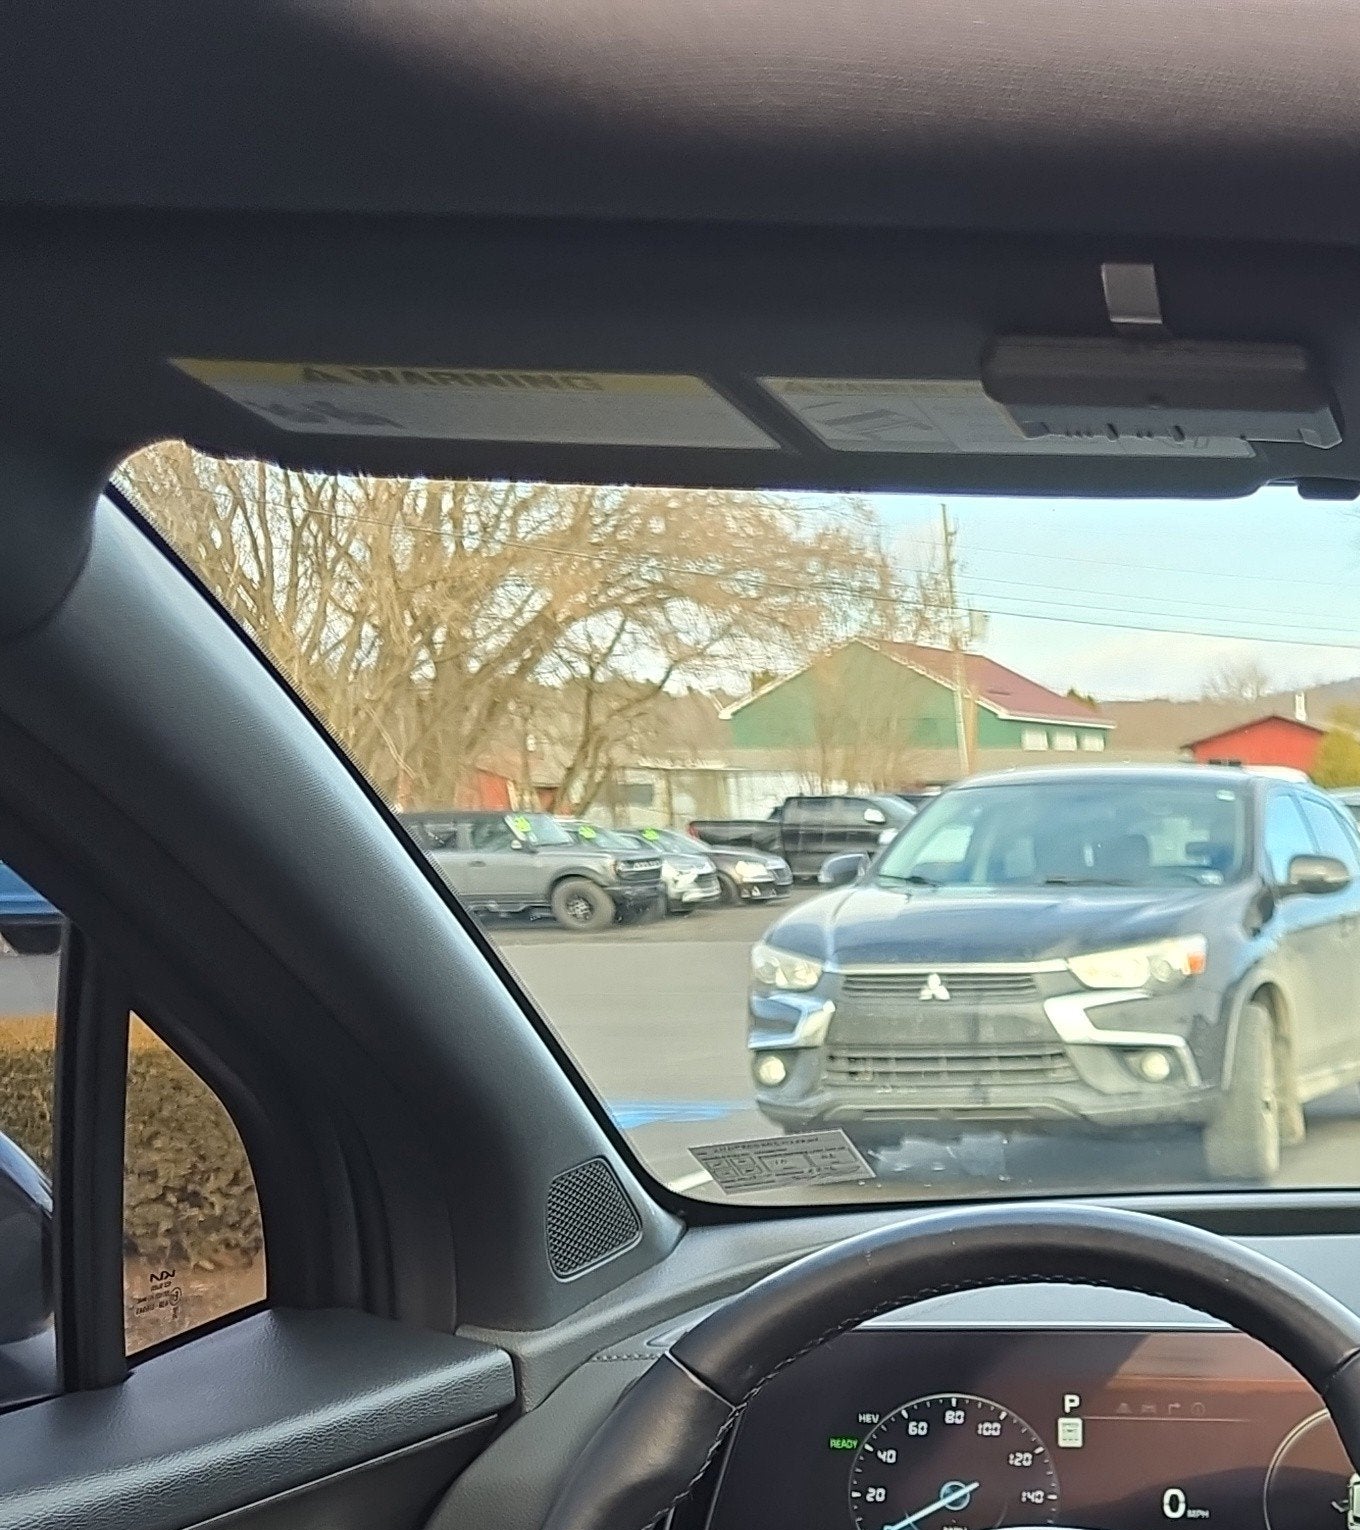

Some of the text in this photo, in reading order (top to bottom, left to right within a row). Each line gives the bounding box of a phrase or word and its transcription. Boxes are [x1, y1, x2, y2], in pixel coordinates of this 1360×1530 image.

[1063, 1394, 1080, 1413] P
[858, 1413, 880, 1424] HEV
[944, 1410, 965, 1424] 80
[908, 1421, 928, 1436] 60
[977, 1422, 1001, 1436] 100
[829, 1438, 859, 1449] READY
[877, 1450, 897, 1464] 40
[1008, 1452, 1033, 1467] 120
[866, 1487, 886, 1502] 20
[1021, 1490, 1045, 1504] 140
[1163, 1488, 1210, 1519] 0 MPH
